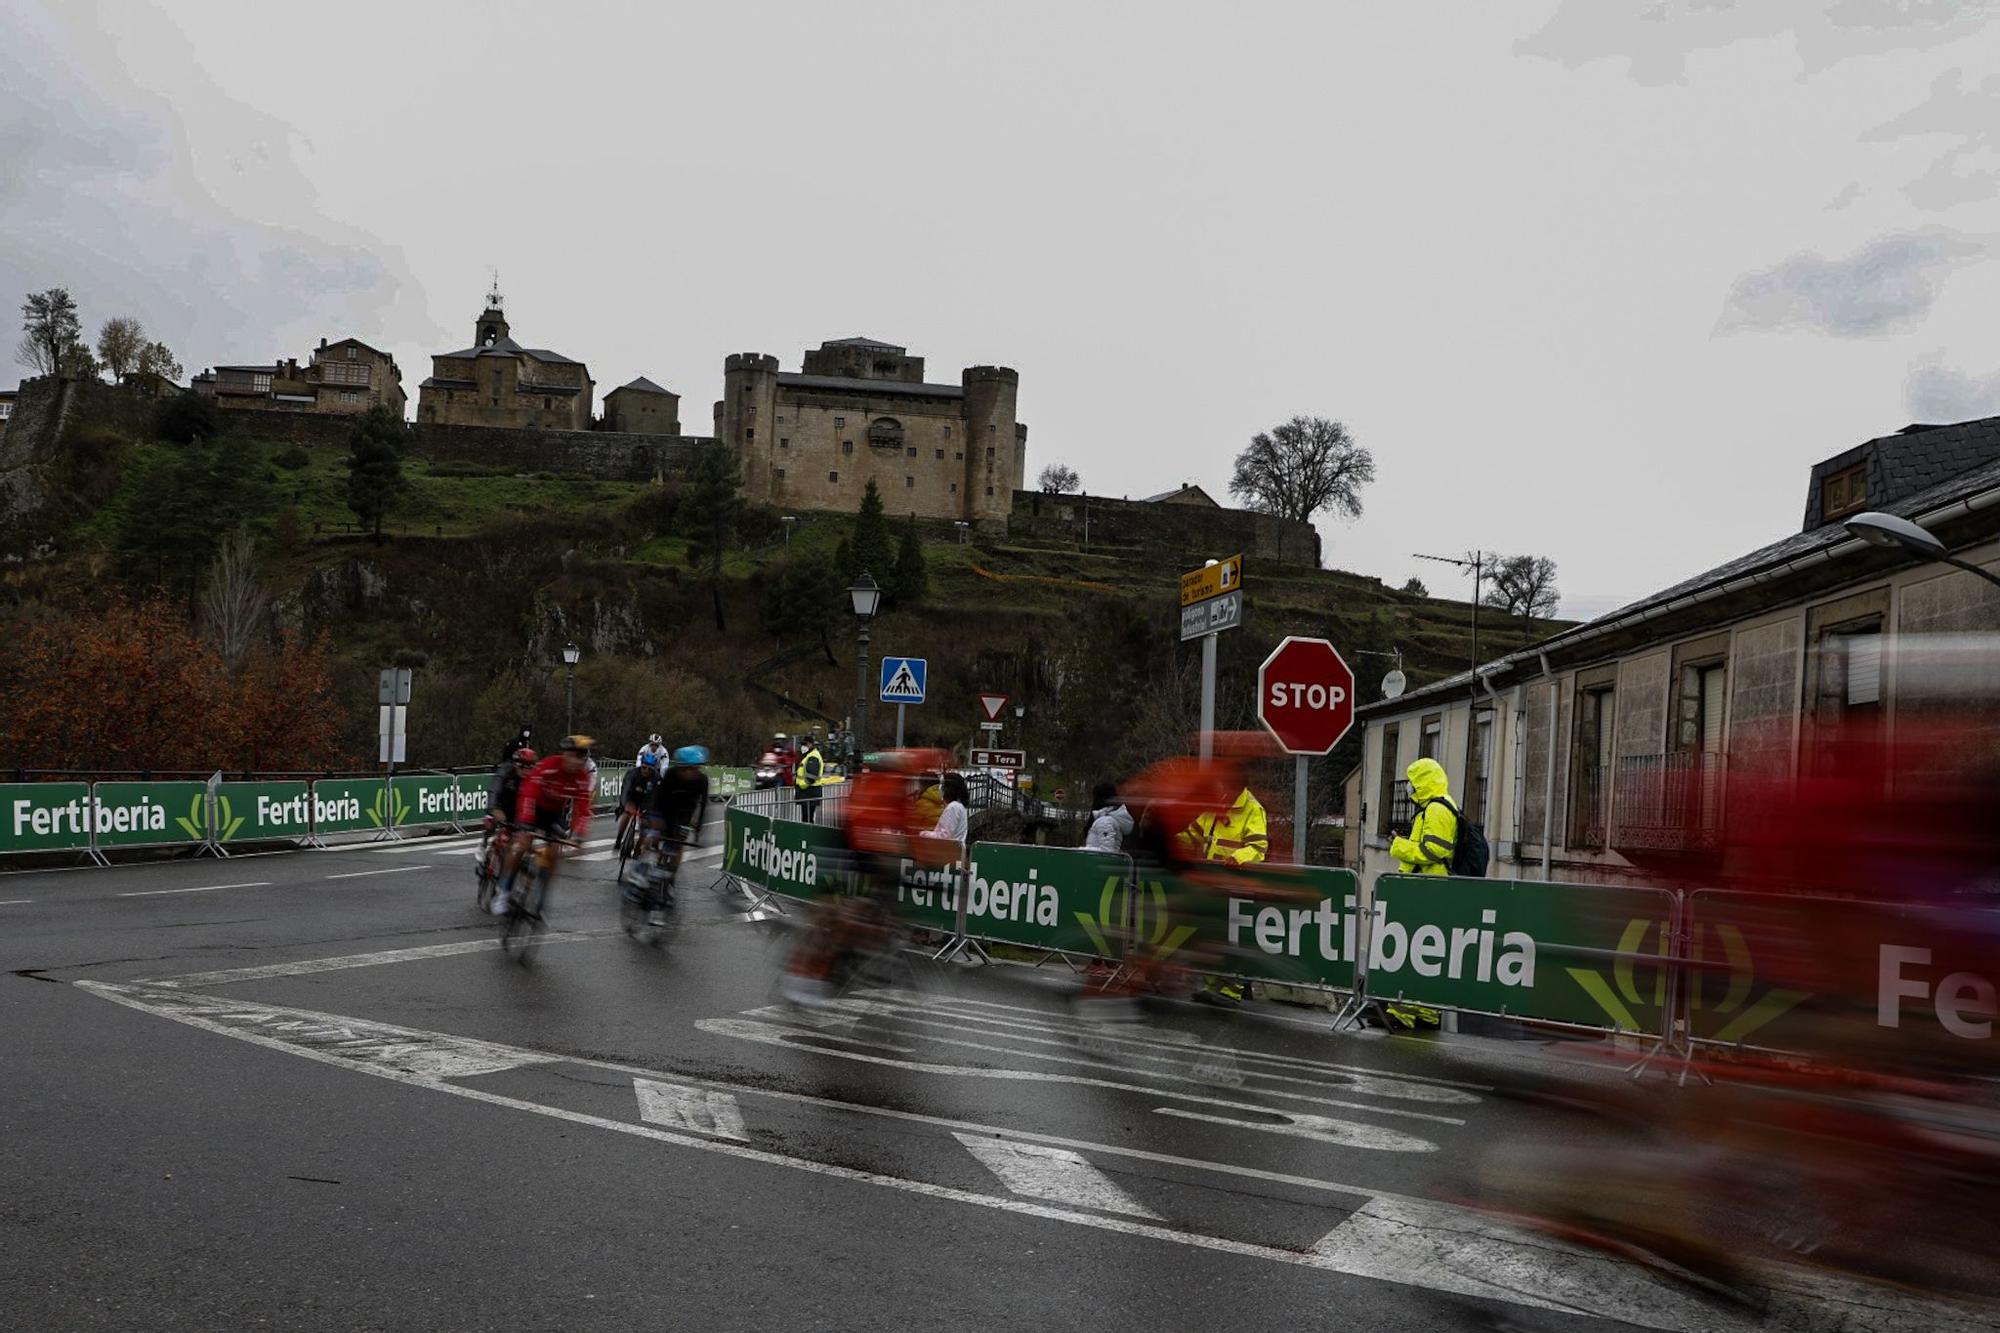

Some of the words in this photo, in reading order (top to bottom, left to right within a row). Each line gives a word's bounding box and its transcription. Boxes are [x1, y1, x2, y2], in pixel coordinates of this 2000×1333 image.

[1271, 682, 1345, 710] STOP
[994, 755, 1016, 764] Tera
[419, 784, 488, 816] Fertiberia
[600, 776, 622, 797] Ferti
[14, 795, 166, 836] Fertiberia
[258, 791, 360, 826] Fertiberia
[742, 827, 817, 885] Fertiberia
[898, 858, 1059, 928] Fertiberia
[1229, 895, 1536, 989] Fertiberia
